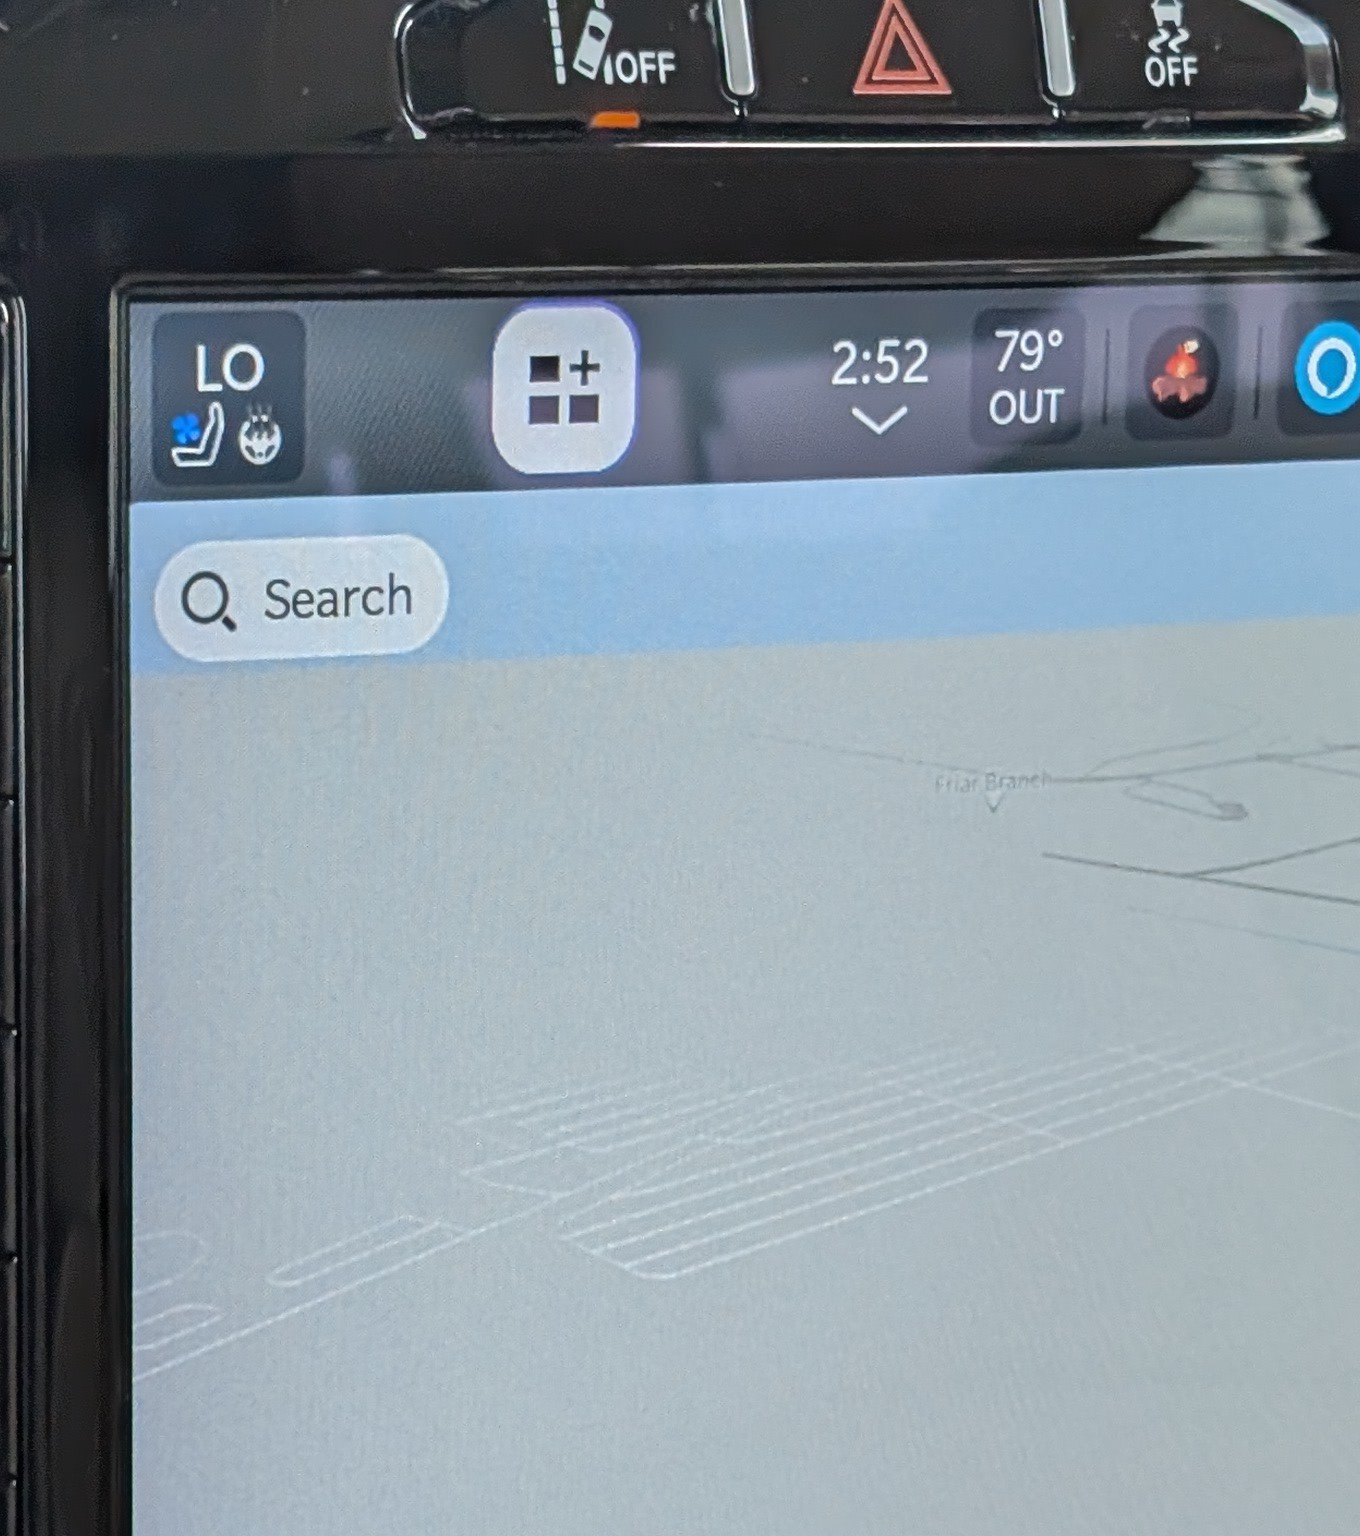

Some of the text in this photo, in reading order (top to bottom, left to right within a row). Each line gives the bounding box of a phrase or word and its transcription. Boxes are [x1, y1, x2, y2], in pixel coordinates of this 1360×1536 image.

[615, 50, 675, 84] OFF
[1144, 54, 1198, 88] OFF
[196, 343, 265, 392] LO
[831, 340, 928, 386] 2:52
[989, 389, 1064, 425] OUT
[264, 573, 413, 620] Search
